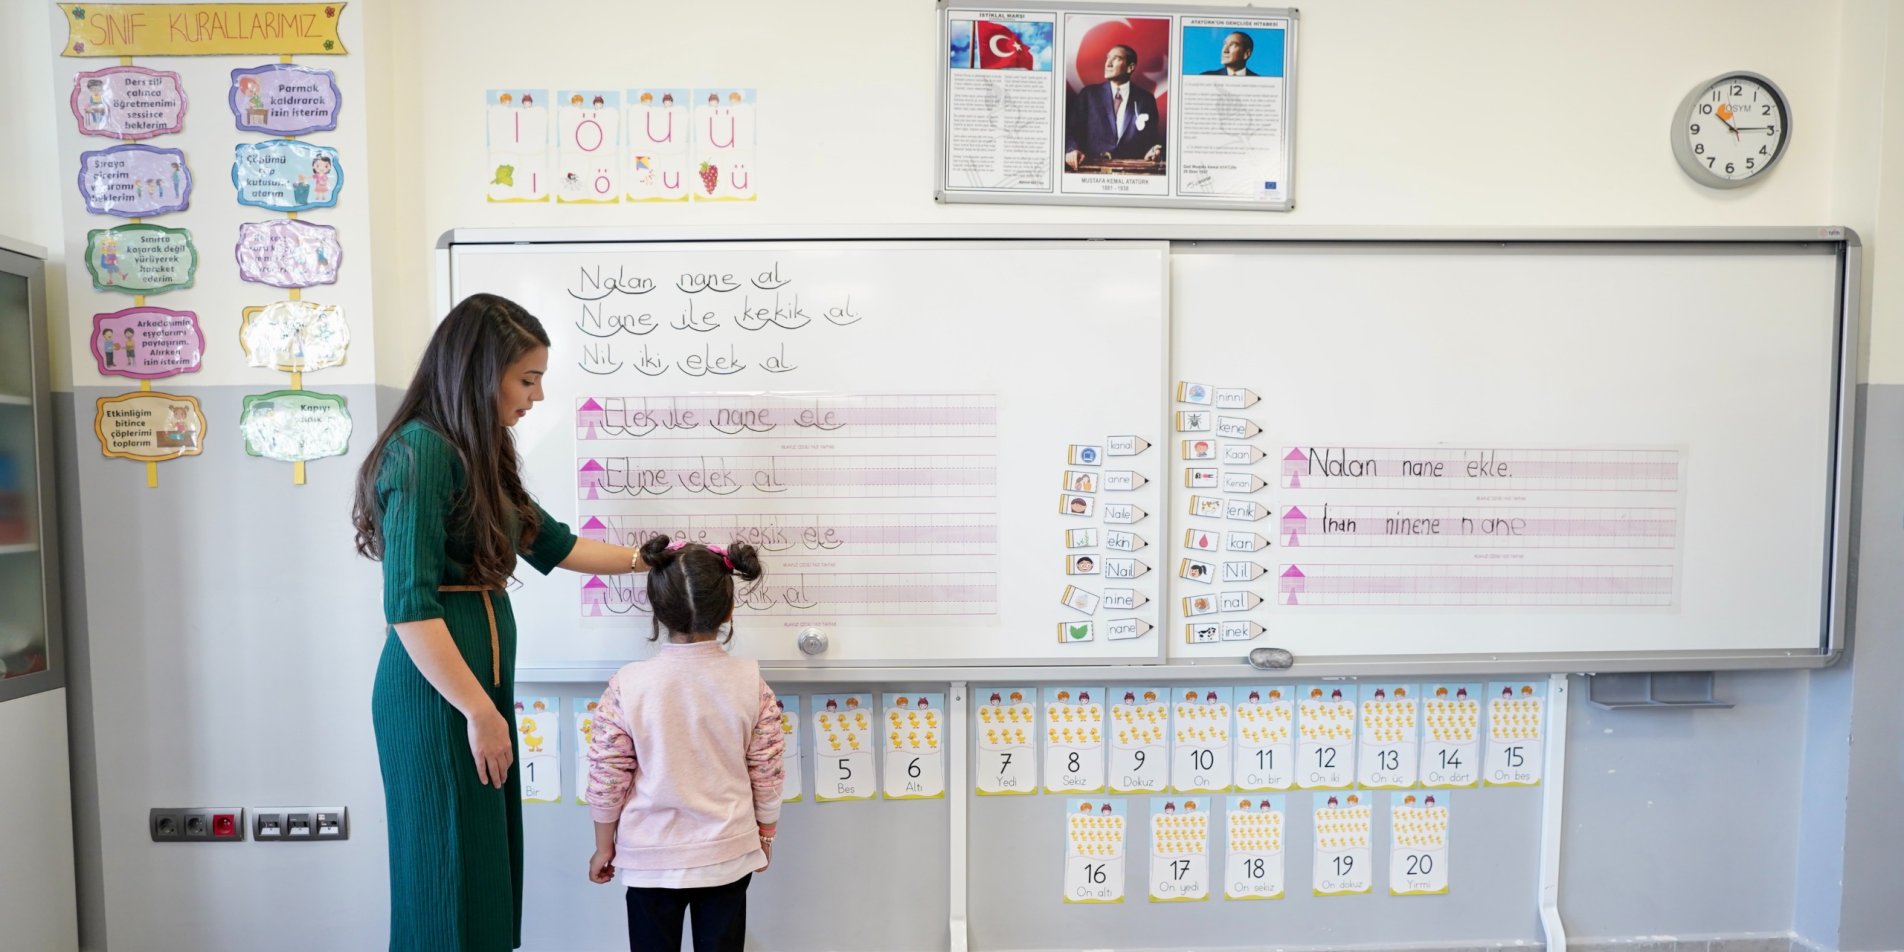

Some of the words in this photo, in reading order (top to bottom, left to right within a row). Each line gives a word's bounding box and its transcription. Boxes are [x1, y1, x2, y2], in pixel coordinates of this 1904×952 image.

[89, 11, 147, 46] SINIF
[169, 11, 323, 43] KURALLARIMIZ
[278, 83, 319, 93] Parmak
[1729, 85, 1743, 96] 12
[270, 96, 325, 106] kaldırarak
[1712, 90, 1721, 102] 11
[1753, 90, 1758, 103] 1
[113, 98, 176, 109] öğretmenimi
[1699, 103, 1712, 115] 10
[270, 109, 289, 117] izin
[291, 107, 329, 117] isterim
[1761, 105, 1771, 116] 2
[1690, 123, 1700, 135] 9
[1766, 125, 1775, 136] 3
[1694, 143, 1705, 155] 8
[1759, 144, 1767, 156] 4
[1706, 157, 1715, 168] 7
[1725, 162, 1735, 174] 6
[1745, 158, 1754, 169] 5
[126, 245, 161, 255] koşarak
[164, 245, 186, 254] değil
[578, 264, 654, 294] Nalan
[579, 302, 654, 332] Nane
[677, 298, 717, 328] ile
[739, 294, 808, 325] kekik
[581, 343, 619, 369] Nil
[638, 343, 662, 371] iki
[683, 343, 743, 371] elek
[106, 409, 152, 419] Etkinliğim
[115, 419, 146, 428] bitince
[1218, 418, 1245, 434] kene
[110, 428, 152, 438] çöplerimi
[112, 439, 151, 448] toplarım
[1110, 439, 1133, 450] kanal
[1225, 447, 1250, 459] Kaan
[1308, 447, 1377, 477] Nalan
[1402, 460, 1444, 478] nane
[1107, 476, 1130, 484] anne
[1225, 479, 1250, 488] Kenan
[1105, 506, 1131, 519] Naile
[1386, 511, 1440, 535] ninene
[1107, 535, 1130, 549] ekin
[1230, 535, 1253, 549] kan
[1108, 562, 1133, 578] Nail
[1225, 563, 1248, 578] Nil
[1105, 594, 1133, 606] nine
[1224, 596, 1245, 609] nal
[1109, 624, 1136, 634] nane
[1225, 623, 1248, 637] inek
[1067, 752, 1080, 772] 8
[1133, 750, 1145, 771] 9
[1190, 749, 1214, 770] 10
[1255, 749, 1273, 770] 11
[1314, 747, 1336, 768] 12
[1377, 750, 1399, 770] 13
[1438, 748, 1462, 769] 14
[1503, 746, 1524, 767] 15
[838, 758, 852, 780] 5
[907, 757, 921, 778] 6
[999, 753, 1012, 774] 7
[526, 762, 535, 783] 1
[996, 776, 1017, 787] Yedi
[1063, 775, 1087, 786] Sekiz
[1123, 775, 1154, 787] Dokuz
[1194, 776, 1210, 787] On
[526, 785, 539, 797] Bir
[1169, 859, 1191, 880] 17
[1243, 858, 1265, 878] 18
[1332, 855, 1354, 876] 19
[1406, 854, 1433, 875] 20
[1084, 863, 1107, 884] 16
[1076, 886, 1093, 897] On
[1159, 881, 1175, 892] On
[1180, 882, 1199, 895] yedi
[1234, 882, 1250, 893] On
